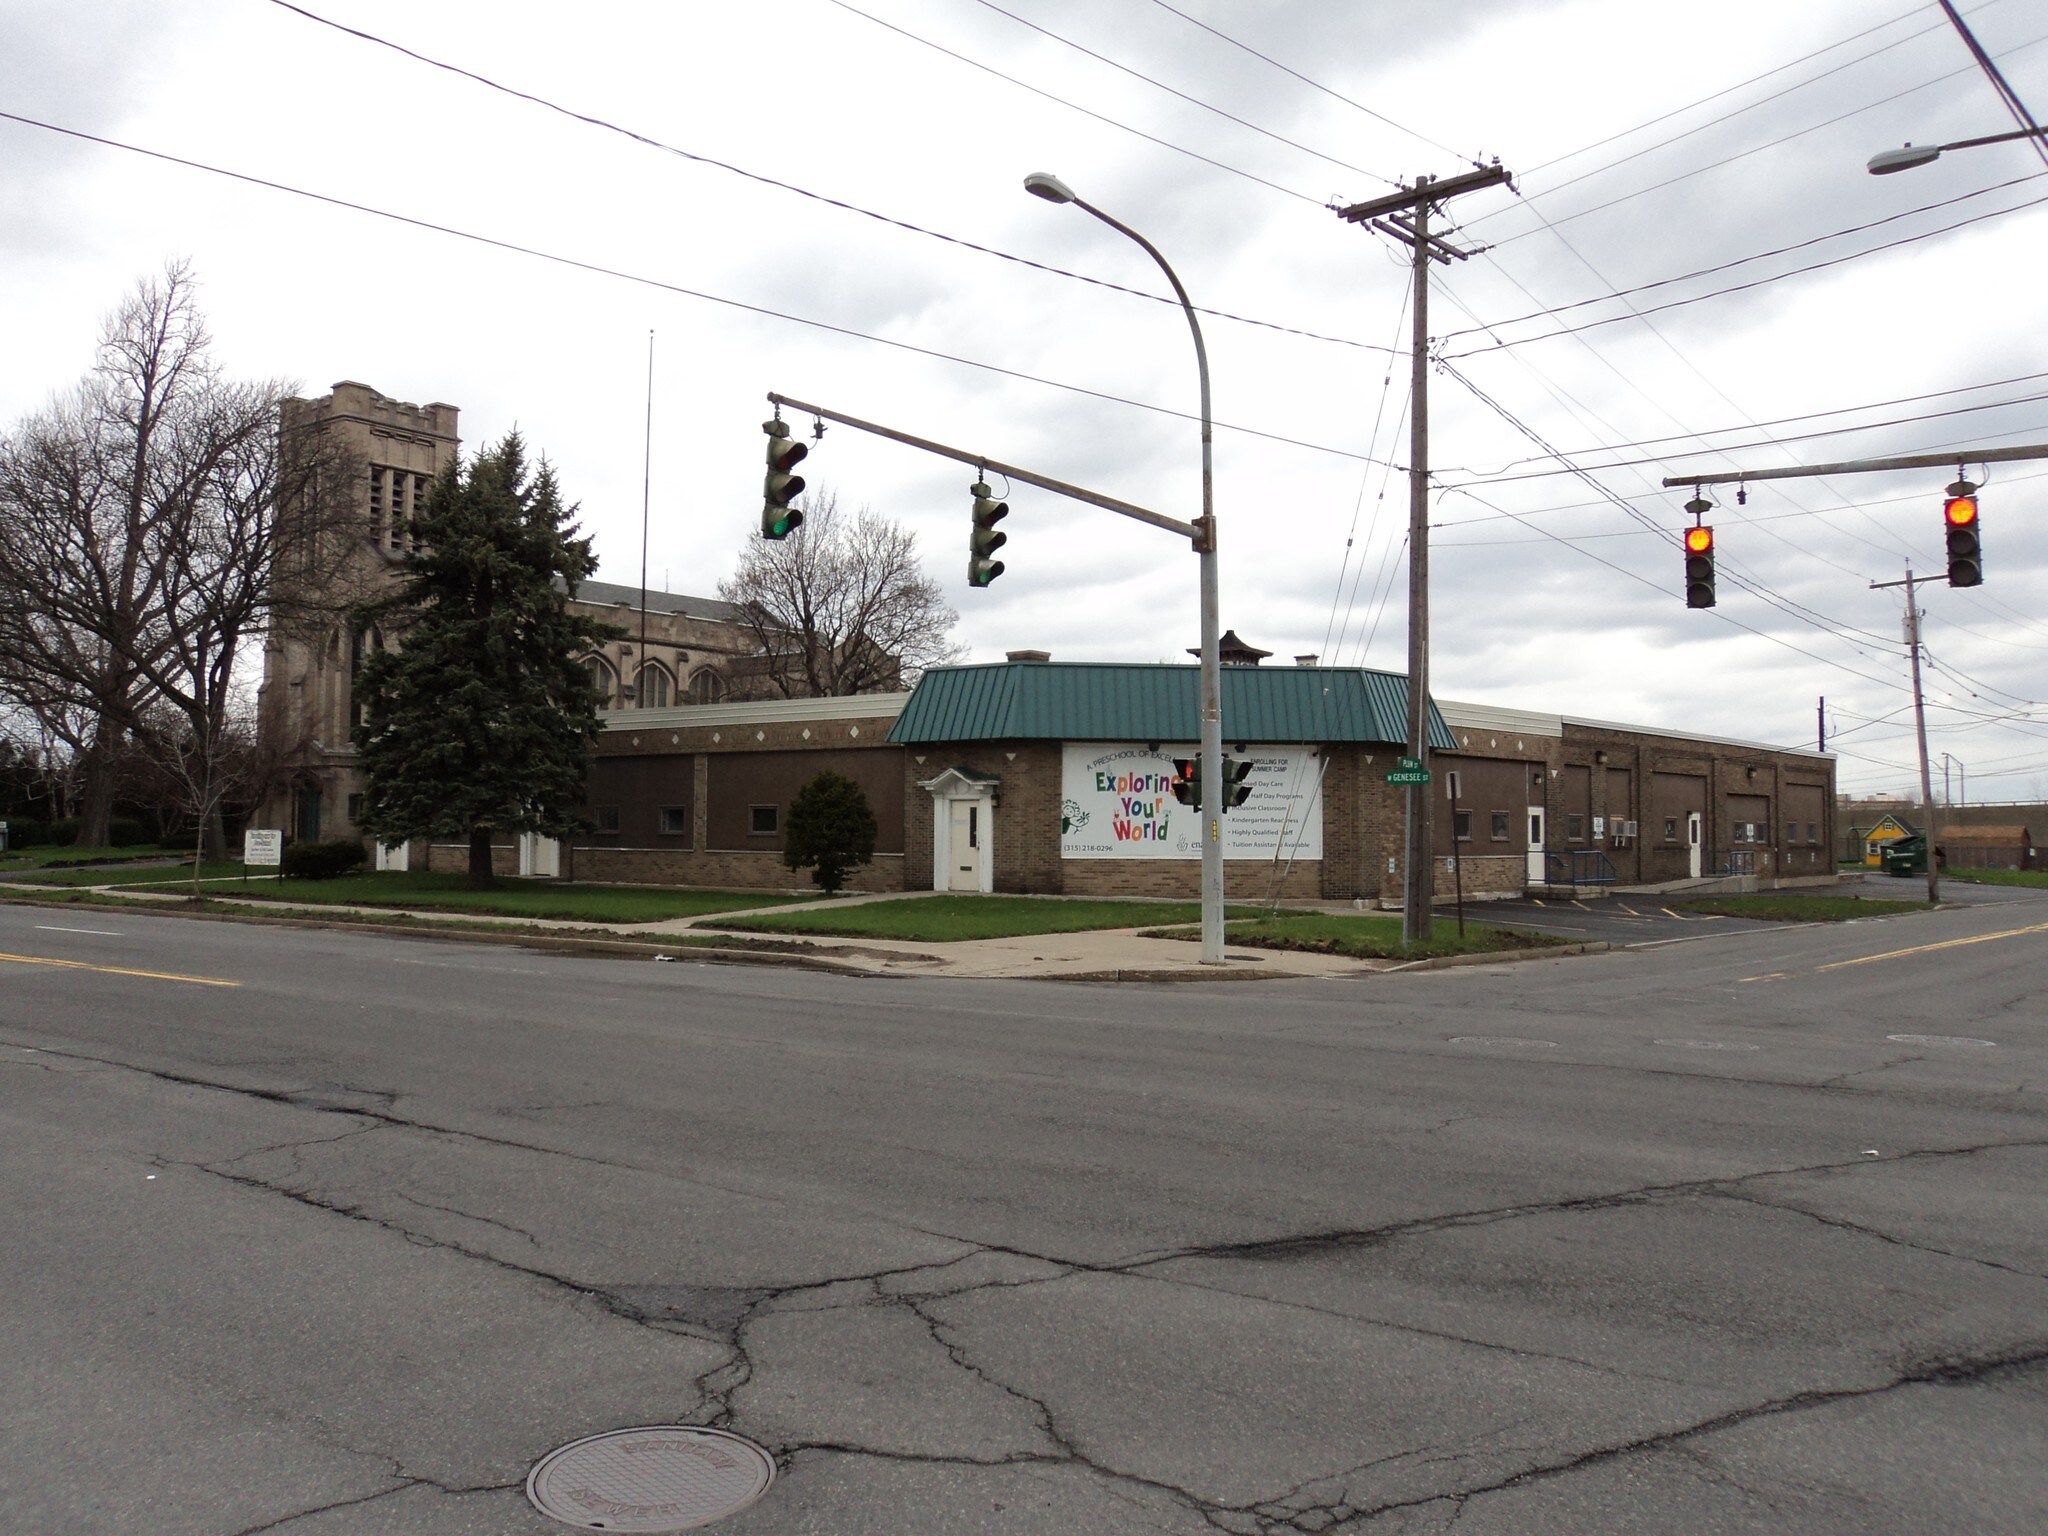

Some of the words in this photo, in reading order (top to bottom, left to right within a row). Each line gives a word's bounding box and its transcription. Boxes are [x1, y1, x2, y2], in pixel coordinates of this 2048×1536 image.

[1093, 751, 1136, 766] PRESCHOOL
[1393, 773, 1421, 781] GENESEE
[1121, 797, 1163, 819] Your
[1112, 820, 1168, 842] World
